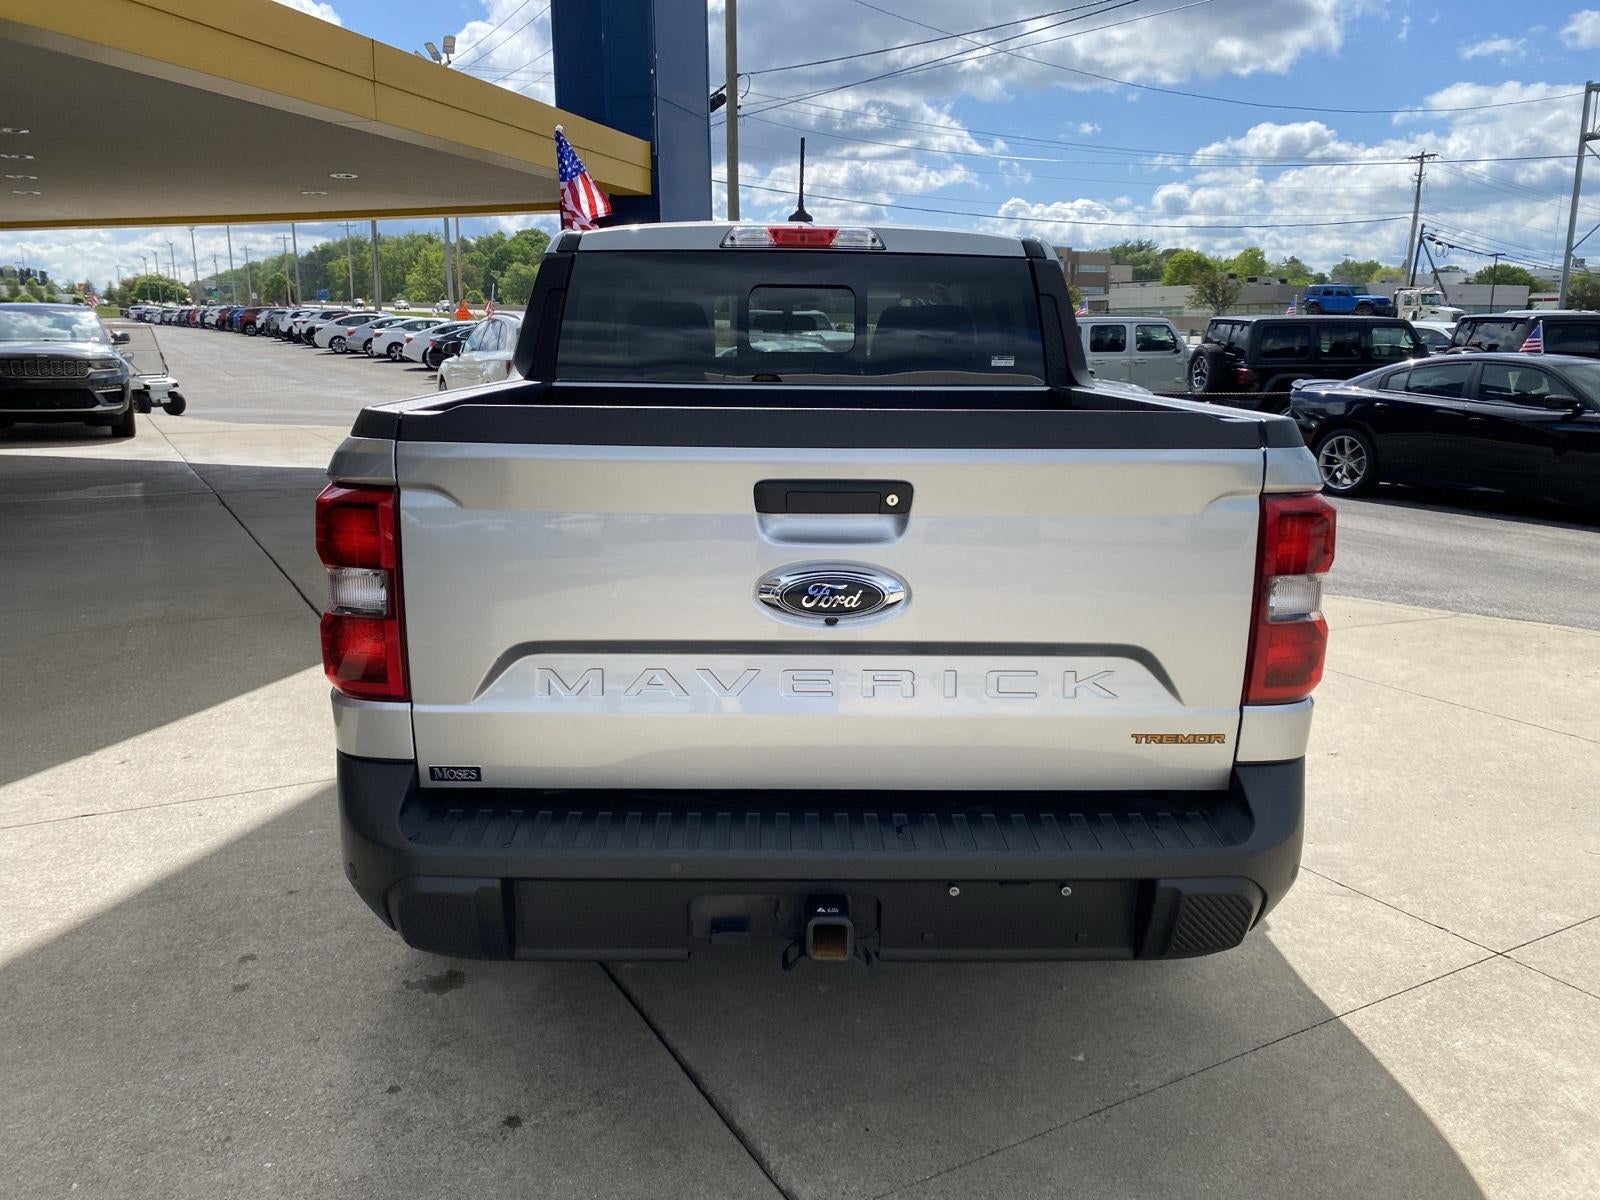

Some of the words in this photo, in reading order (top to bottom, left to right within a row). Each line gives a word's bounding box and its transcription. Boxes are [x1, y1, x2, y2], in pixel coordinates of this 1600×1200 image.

[801, 583, 863, 608] Ford
[535, 668, 1120, 699] MAVERICK
[1131, 733, 1226, 744] TREMOR
[433, 767, 478, 780] MOSES
